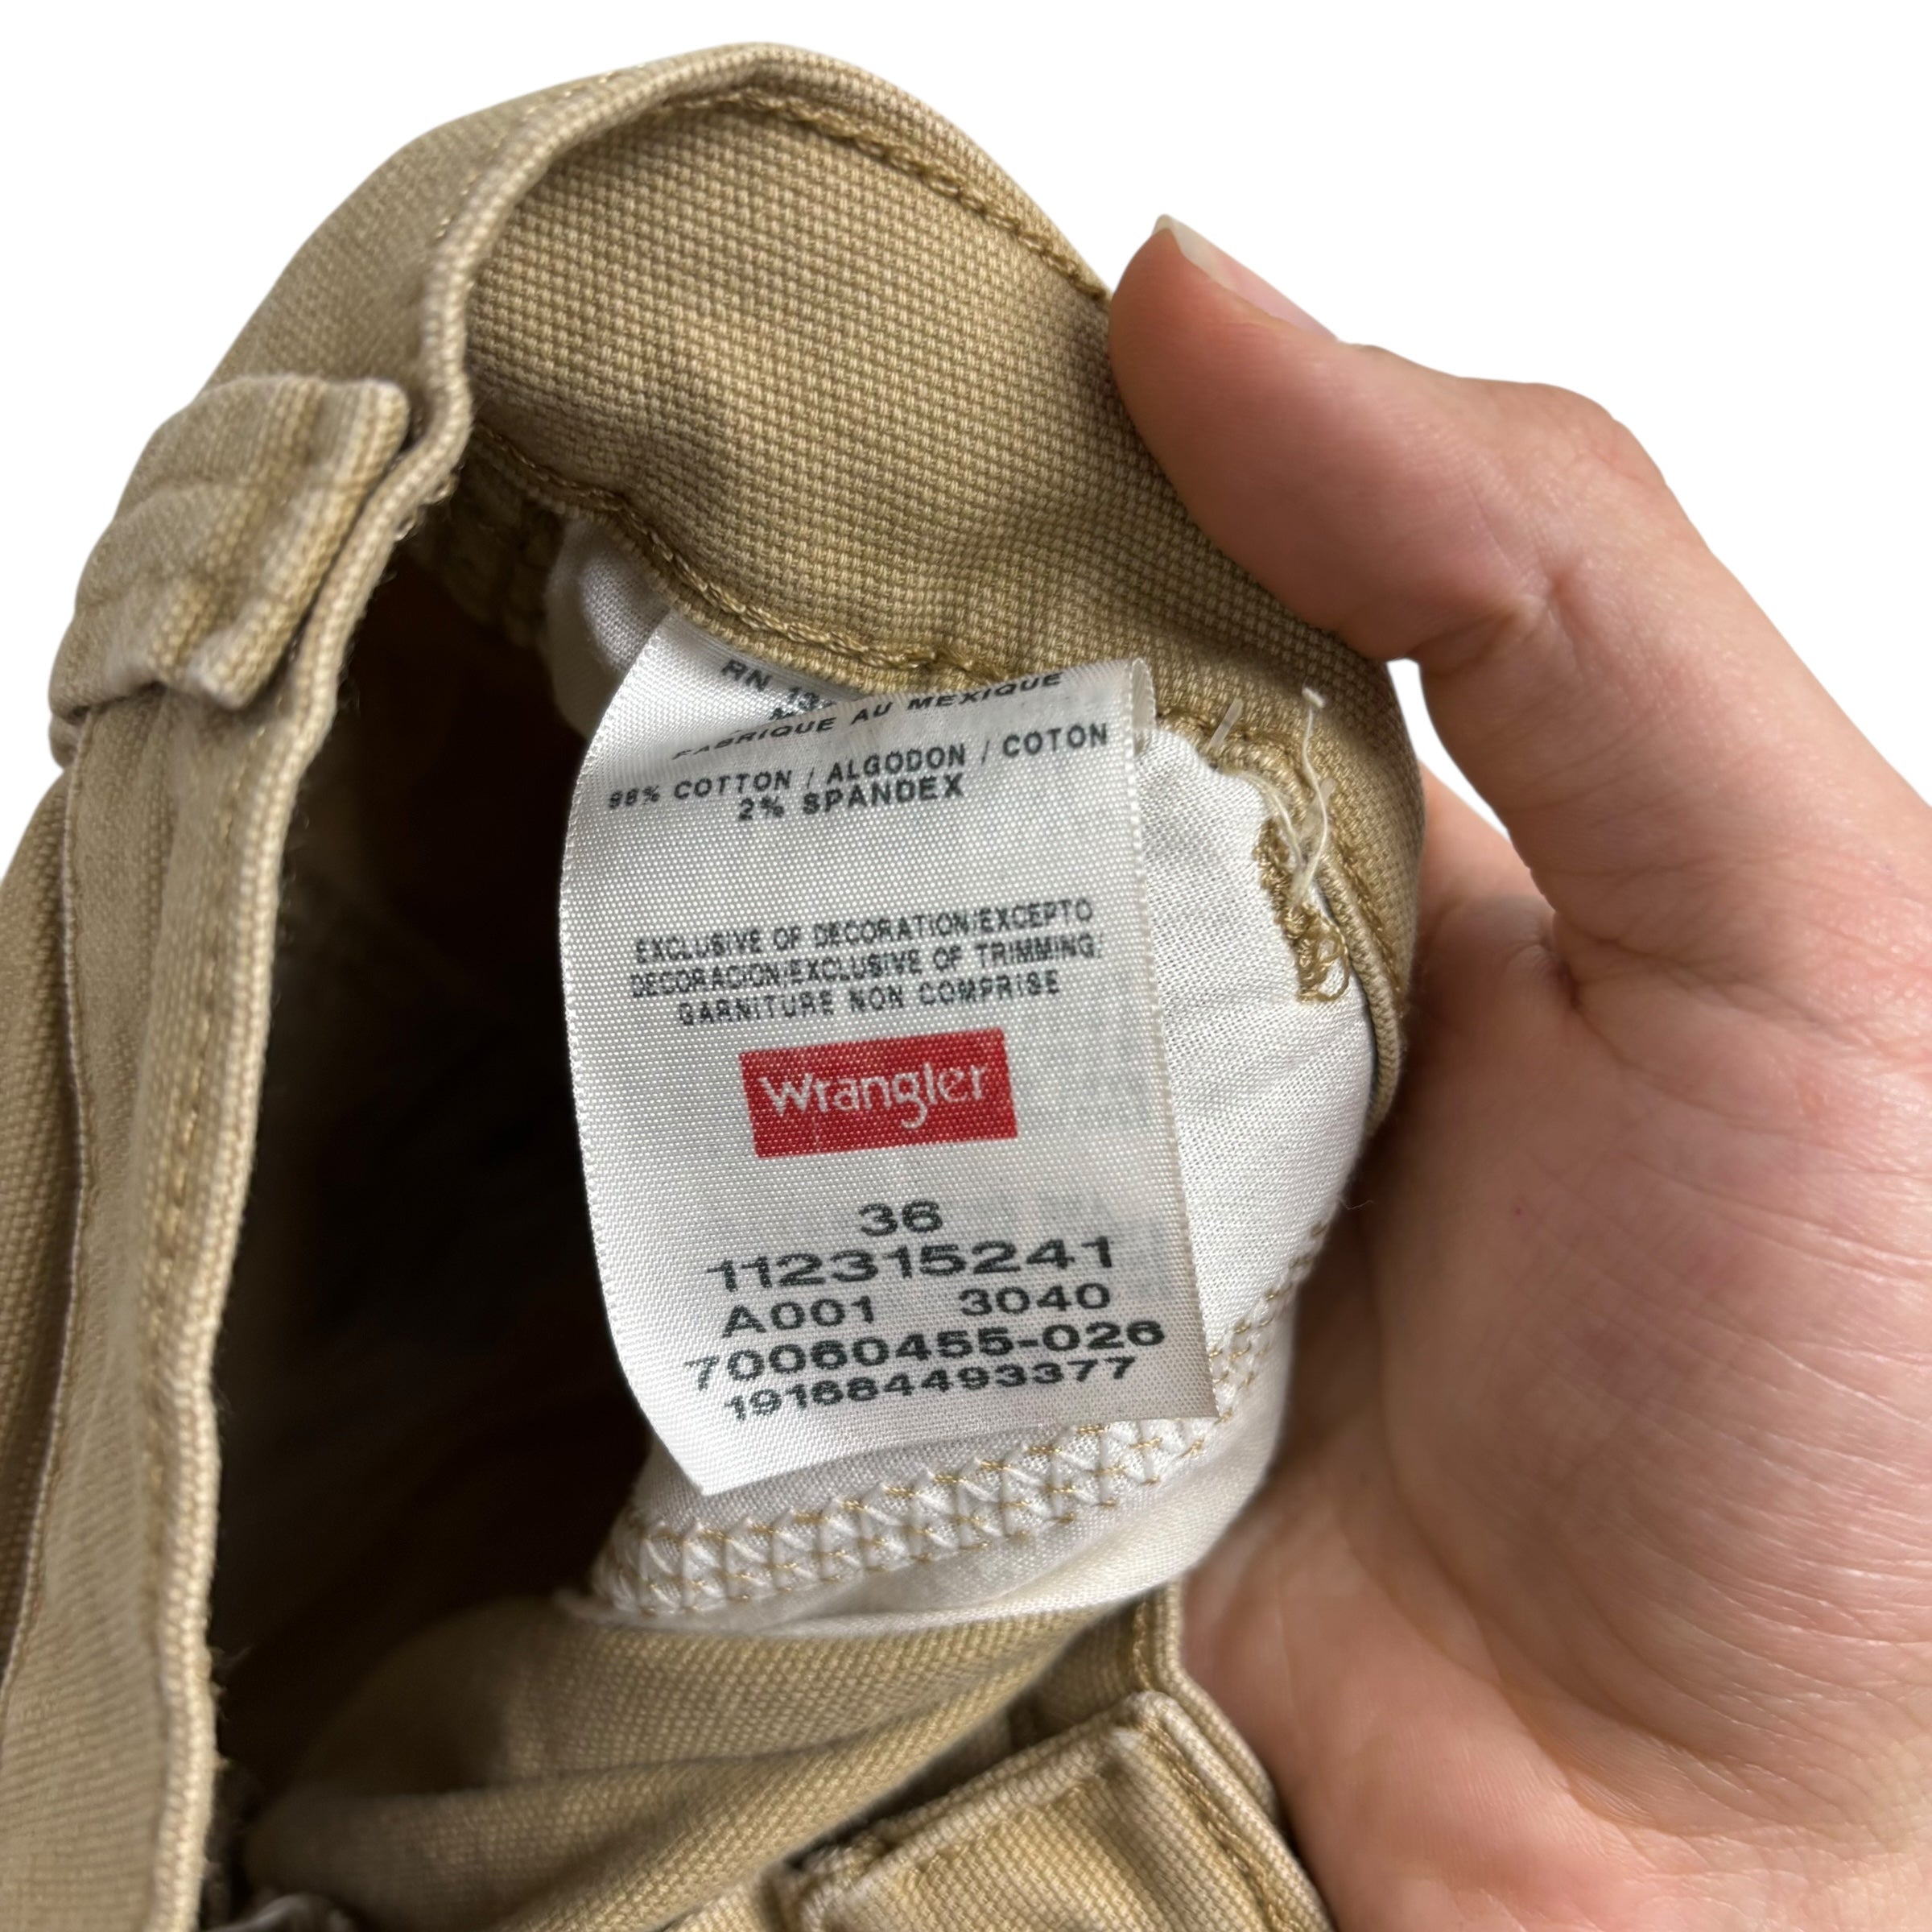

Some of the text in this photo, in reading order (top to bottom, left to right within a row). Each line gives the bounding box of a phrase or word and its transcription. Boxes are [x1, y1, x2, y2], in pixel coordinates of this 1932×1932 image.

[720, 658, 773, 692] RN
[850, 702, 893, 725] AU
[906, 671, 1063, 712] MEXIQUE
[609, 785, 661, 810] 98%
[673, 770, 792, 800] COTTON
[826, 742, 966, 786] ALGODON
[1002, 722, 1108, 758] COTON
[738, 773, 964, 822] 2% SPANDEX
[635, 927, 763, 964] EXCLUSIVE
[773, 925, 802, 952] OF
[932, 944, 962, 972] OF
[679, 968, 1061, 1026] GARNITURE NON COMPRISE
[757, 1062, 990, 1130] Wrangler
[858, 1199, 944, 1236] 36
[707, 1235, 1113, 1293] 112315241
[721, 1282, 1112, 1339] A001 3040
[684, 1319, 1166, 1391] 70060455-026
